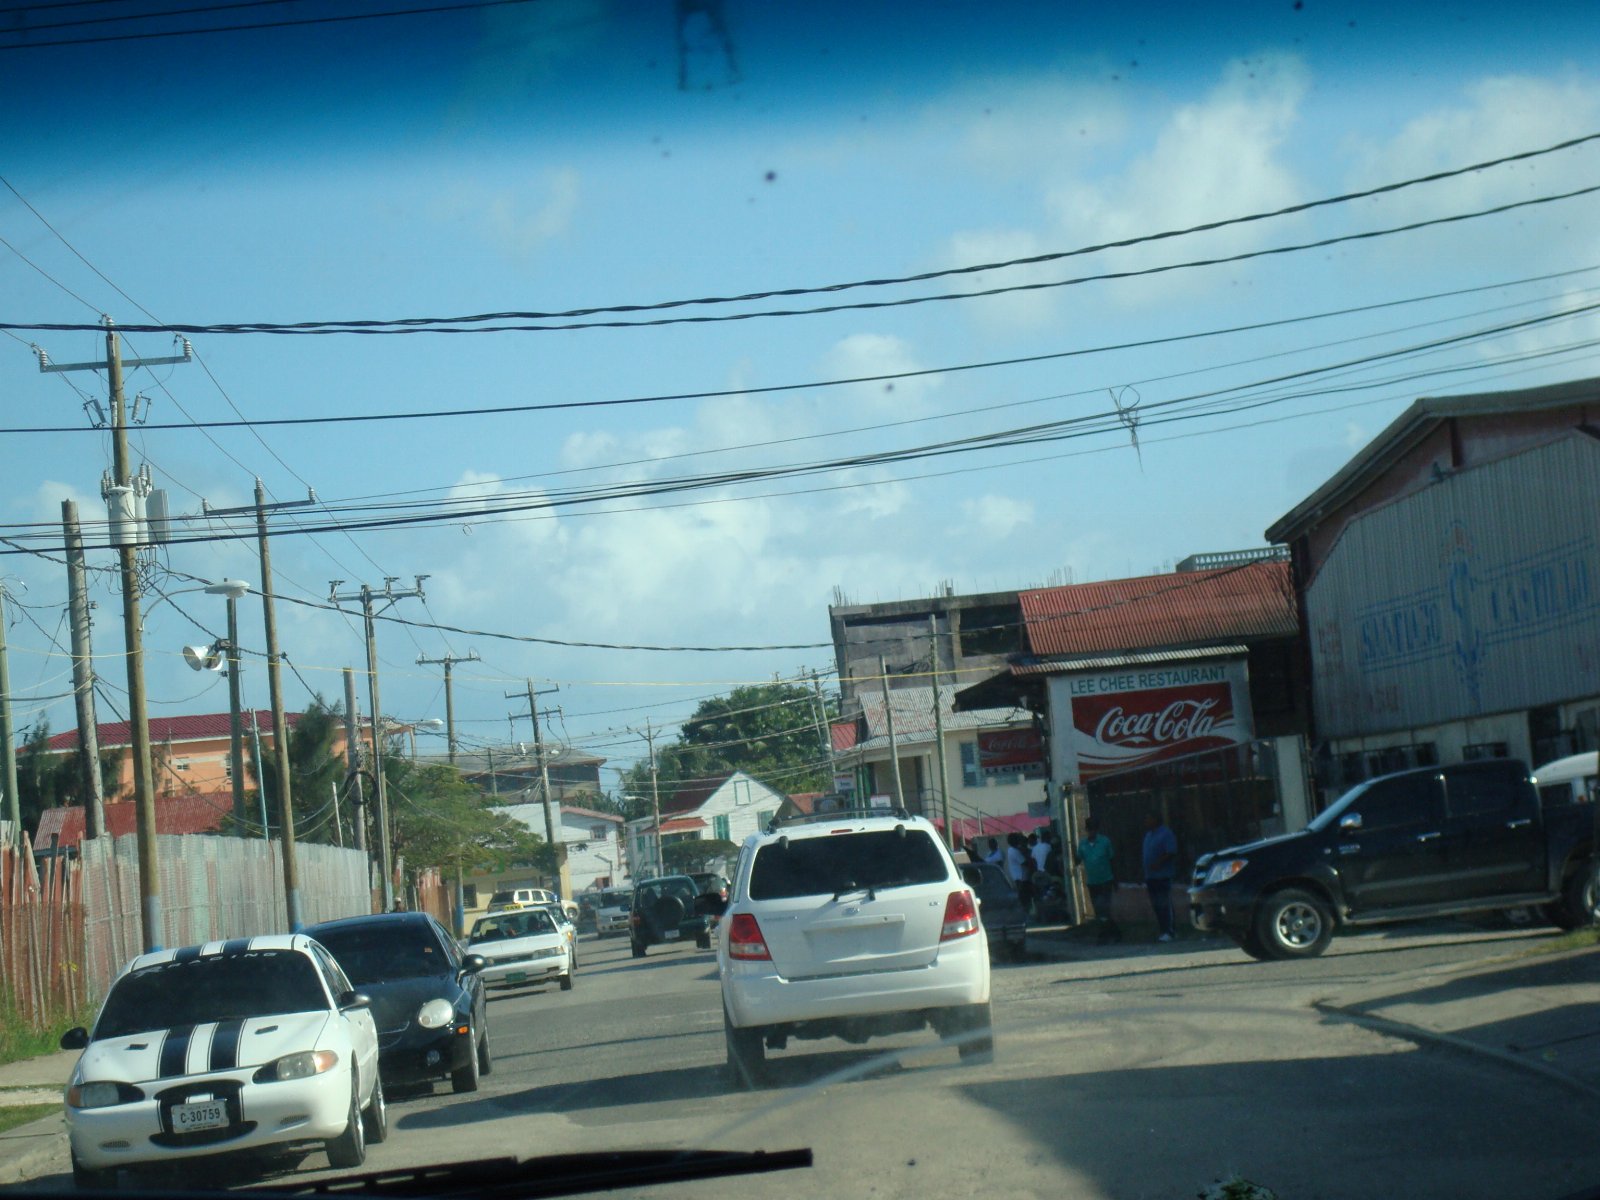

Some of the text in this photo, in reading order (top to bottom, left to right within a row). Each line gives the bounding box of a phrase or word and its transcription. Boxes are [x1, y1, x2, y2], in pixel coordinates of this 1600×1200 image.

[1070, 666, 1226, 695] LEE CHEE RESTAURANT
[1095, 698, 1220, 752] Coca-Cola
[180, 1108, 221, 1124] C-30759
